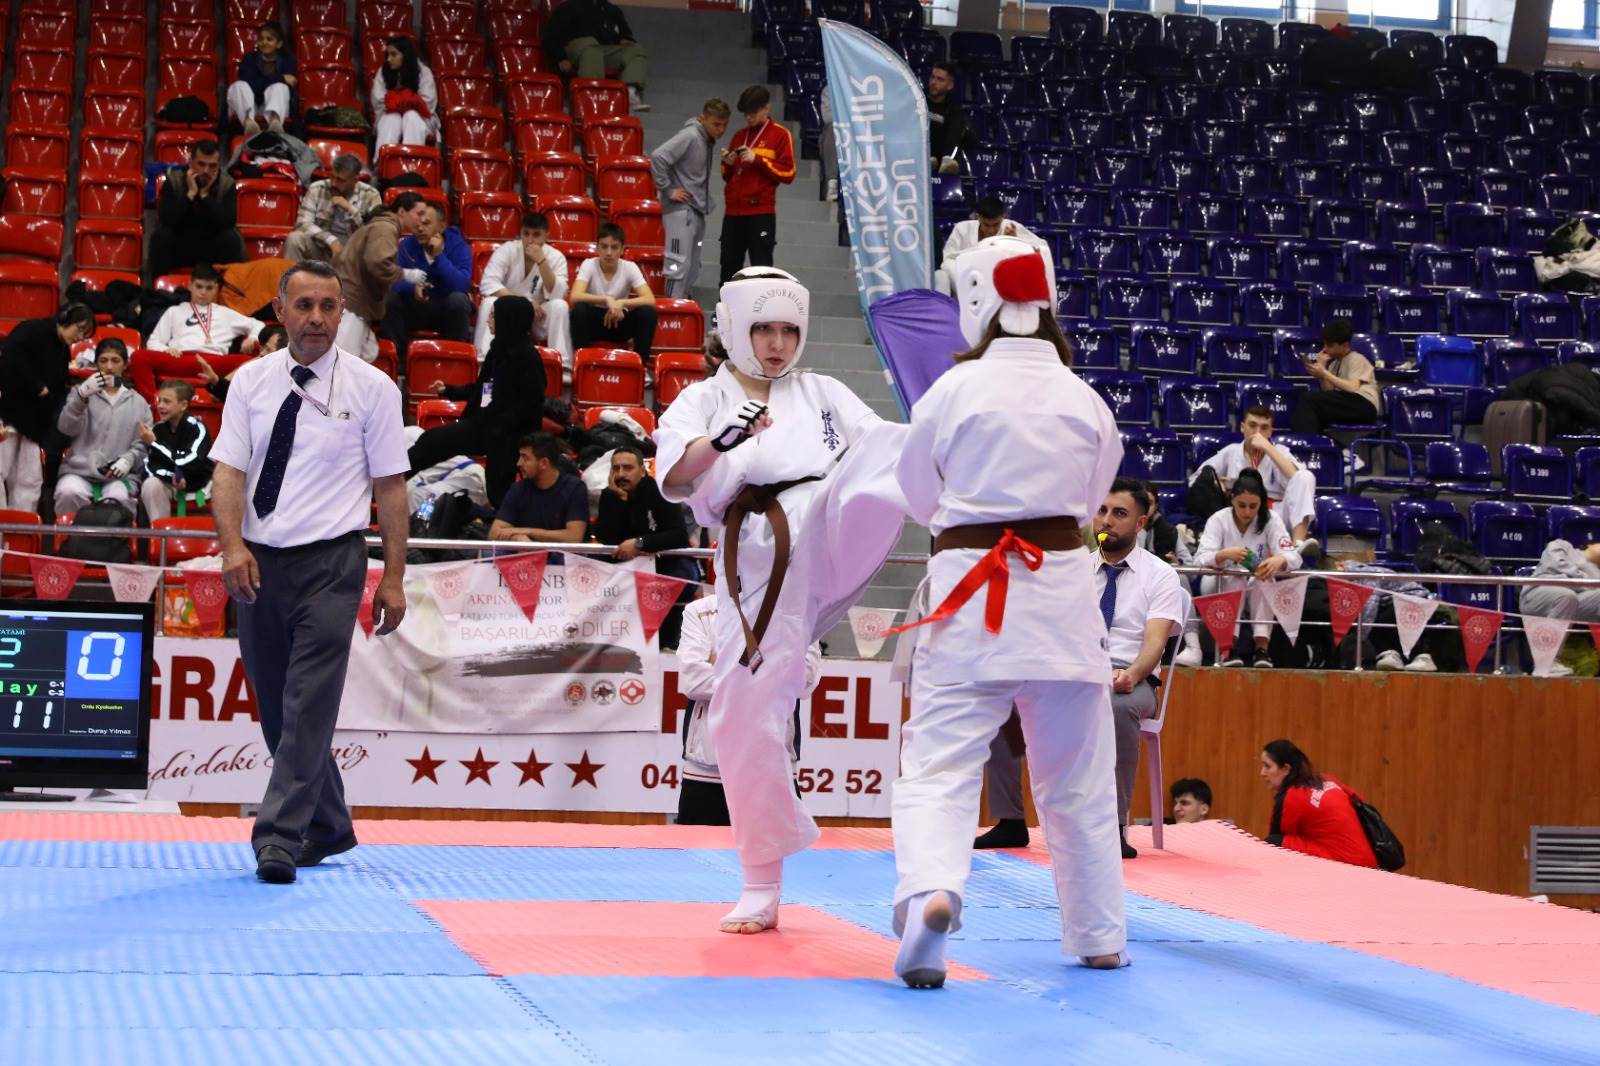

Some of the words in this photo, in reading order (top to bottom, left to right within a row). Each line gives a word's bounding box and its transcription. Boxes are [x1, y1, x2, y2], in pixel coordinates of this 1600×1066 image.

[606, 374, 620, 384] 444
[1478, 592, 1491, 602] 591
[77, 632, 126, 681] 0
[845, 769, 882, 794] 52
